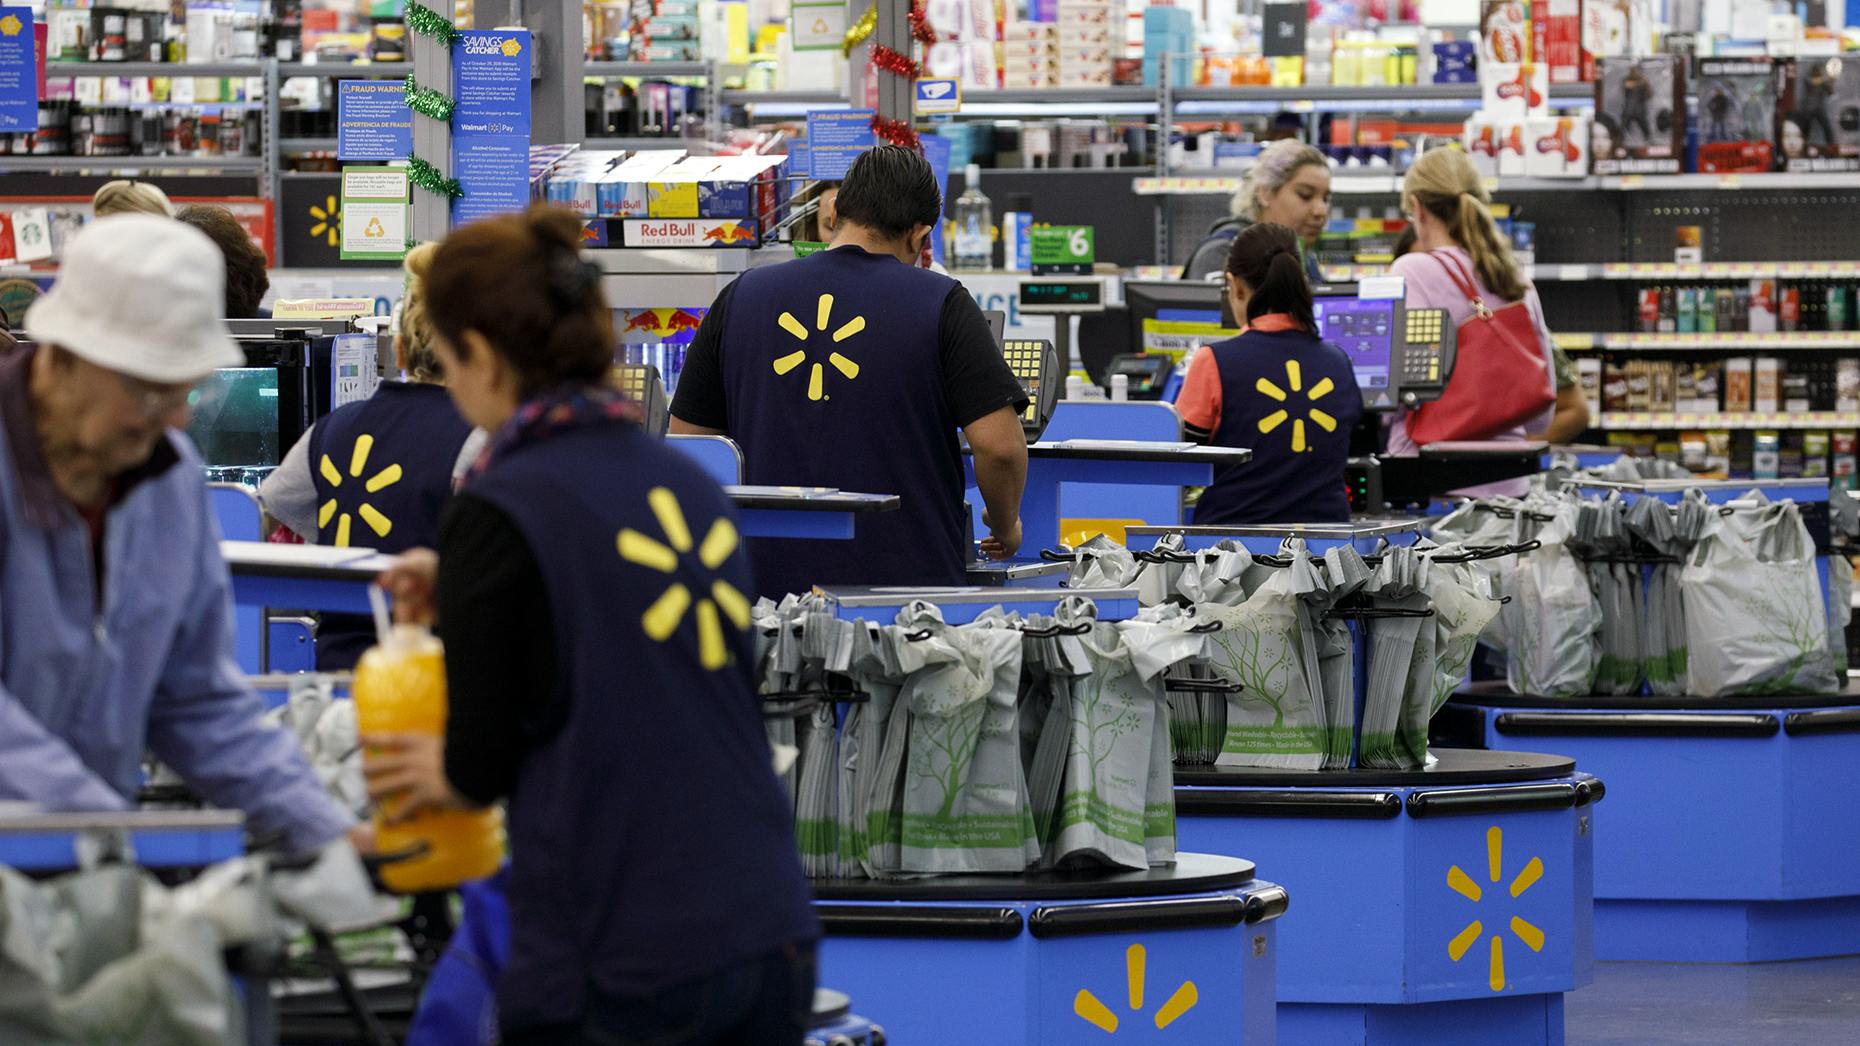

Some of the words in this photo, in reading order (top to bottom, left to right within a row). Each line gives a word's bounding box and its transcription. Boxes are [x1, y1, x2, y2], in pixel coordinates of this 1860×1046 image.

[462, 36, 503, 47] SAVINGS
[465, 46, 500, 54] CATCHER
[502, 124, 514, 133] Pay
[574, 200, 591, 208] Bull
[623, 200, 641, 208] Bull
[641, 223, 667, 236] Red
[670, 223, 695, 236] Bull
[969, 832, 983, 840] the
[984, 832, 1001, 840] USA
